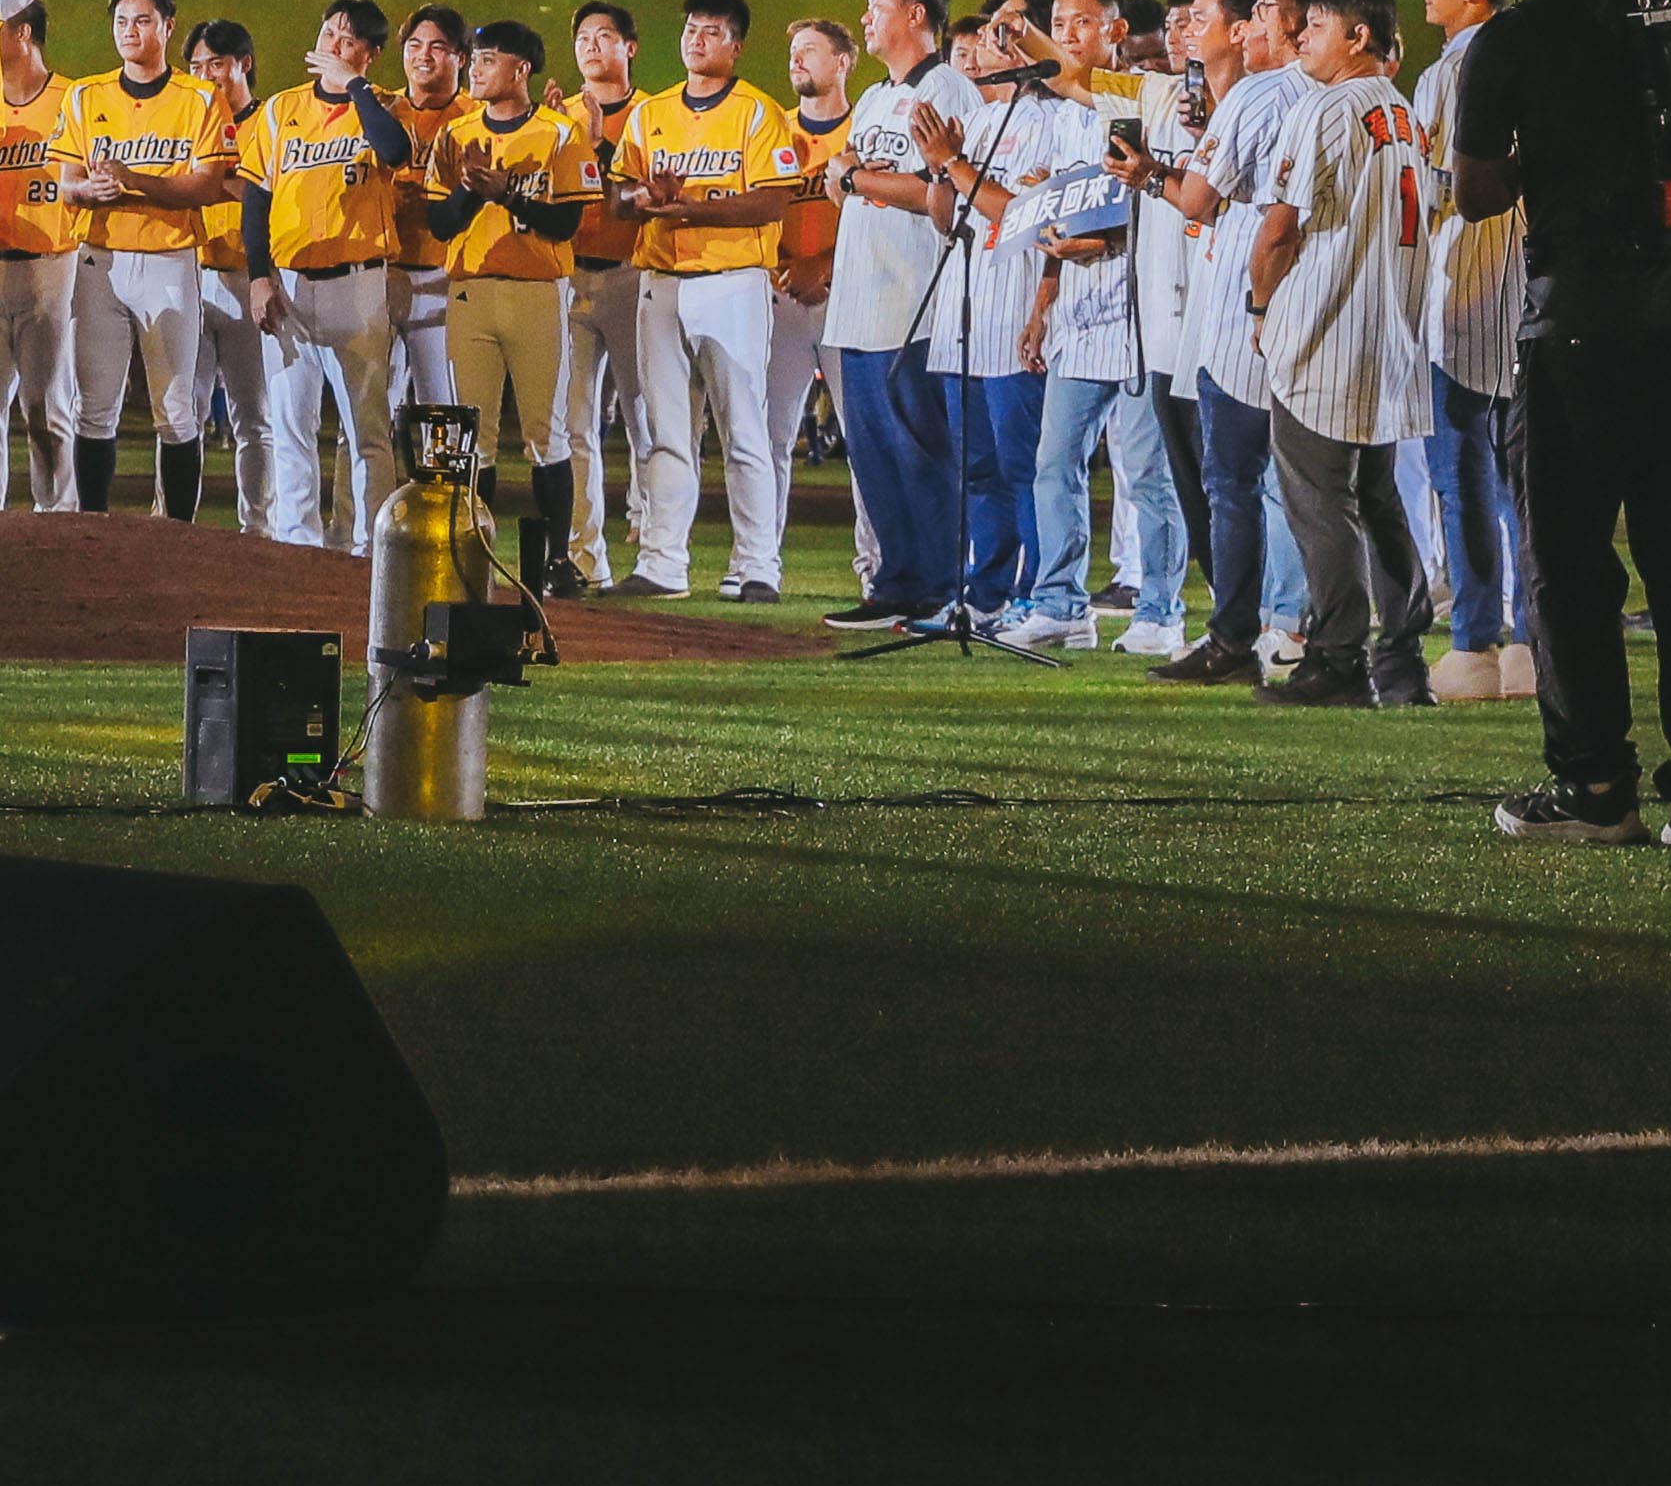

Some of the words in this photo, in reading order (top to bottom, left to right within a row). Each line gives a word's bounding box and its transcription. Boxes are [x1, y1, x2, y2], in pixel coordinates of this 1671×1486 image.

[90, 132, 194, 166] Brothers
[651, 147, 743, 178] Brothers
[344, 163, 369, 186] 57
[27, 180, 59, 204] 29
[1399, 164, 1420, 248] 1
